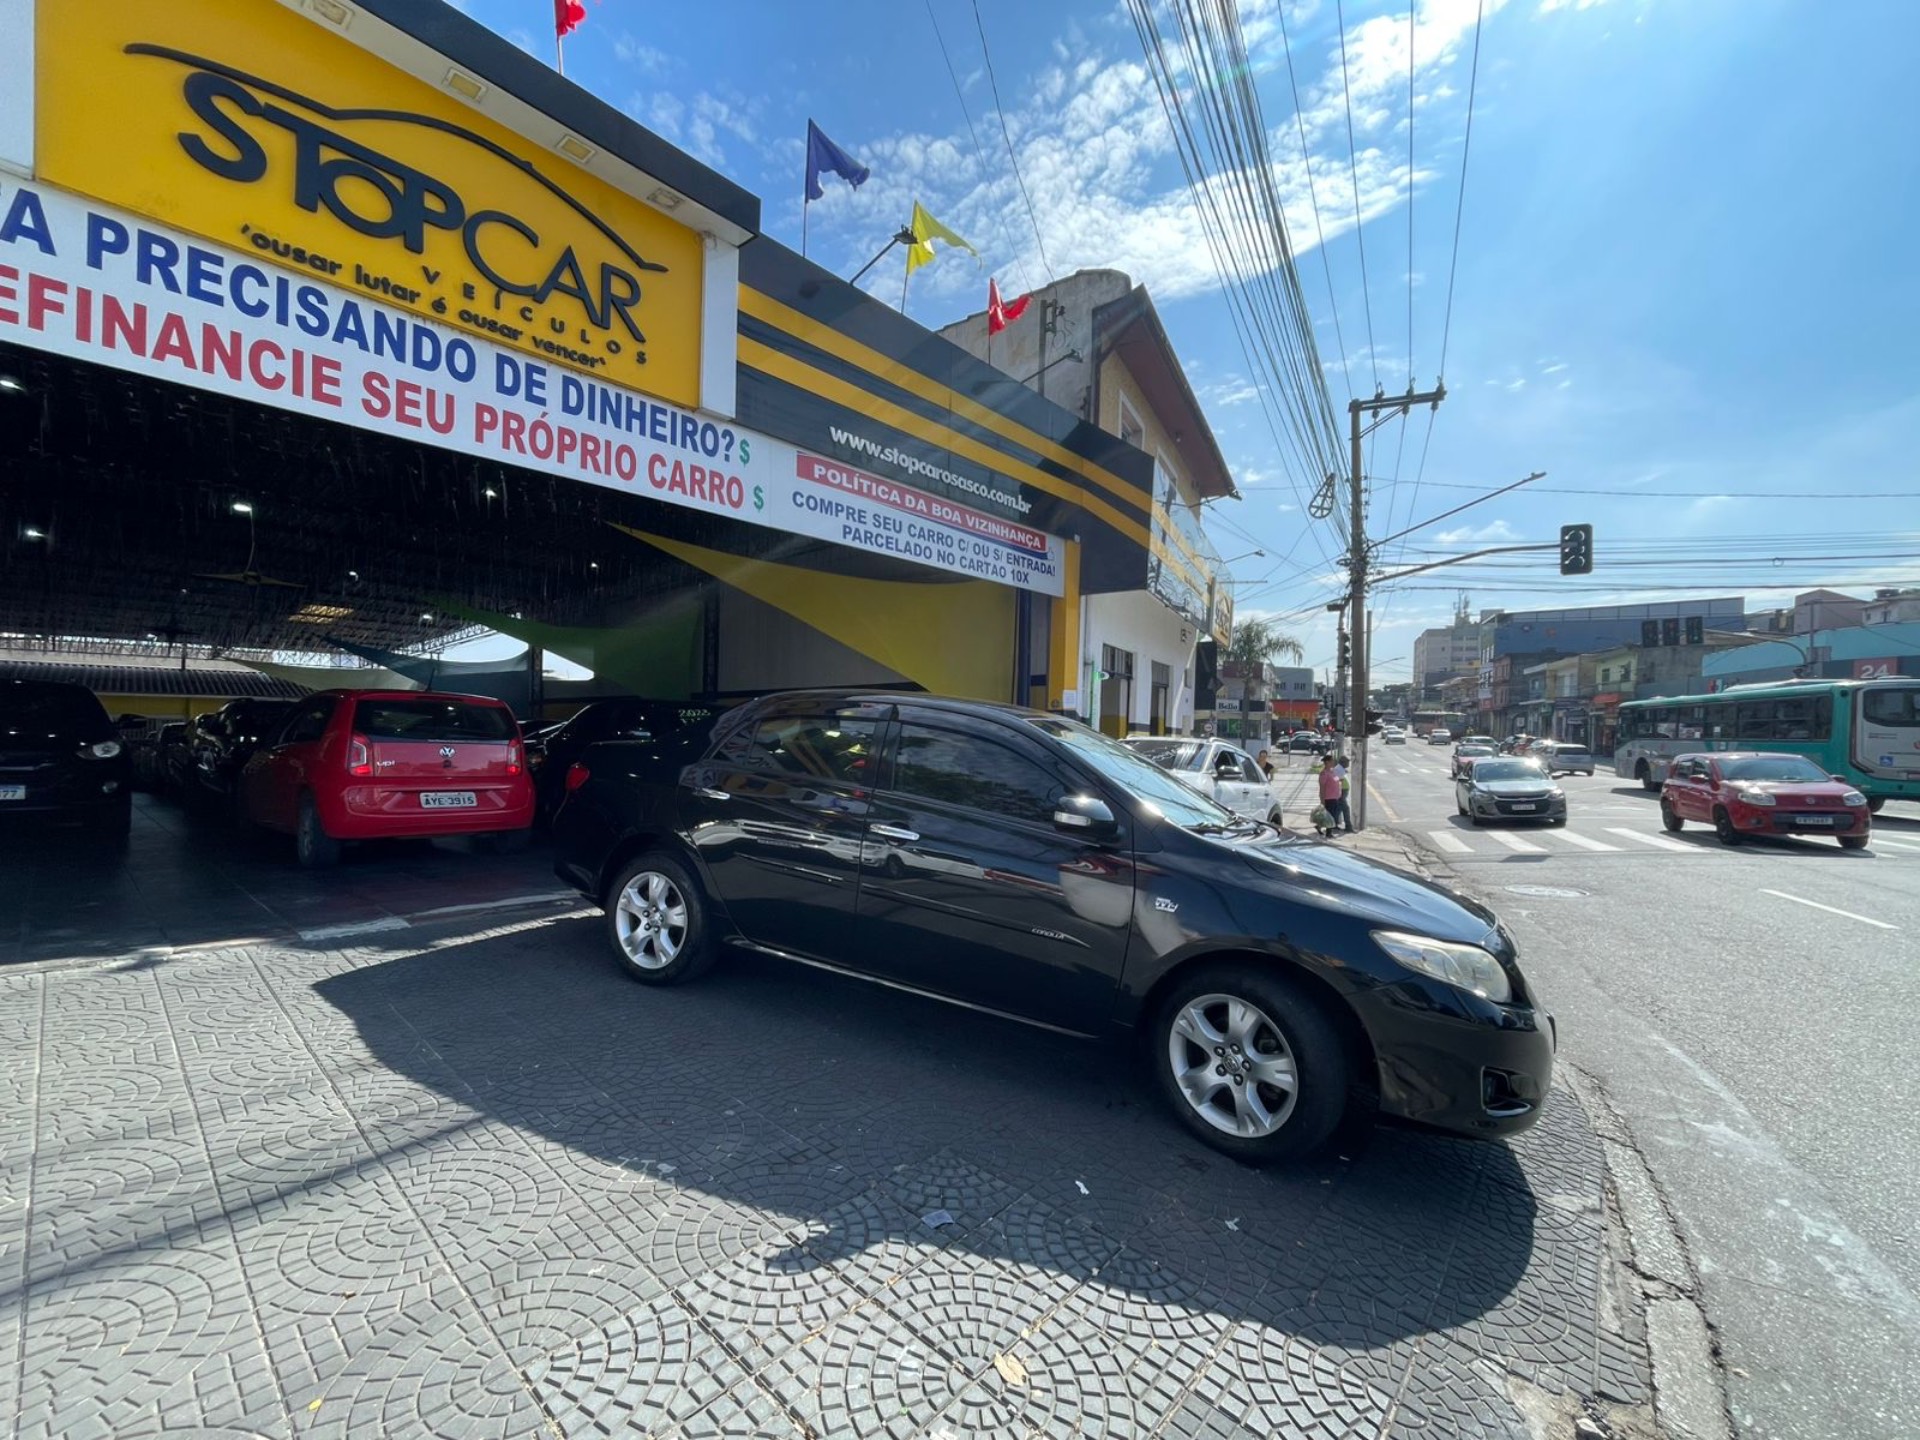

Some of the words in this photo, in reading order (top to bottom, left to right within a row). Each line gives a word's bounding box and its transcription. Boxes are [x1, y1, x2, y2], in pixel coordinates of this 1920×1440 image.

[87, 211, 476, 383] PRECISANDO
[496, 352, 547, 407] DE
[561, 374, 735, 462] DINHEIRO?
[355, 264, 421, 304] lutar
[431, 297, 447, 315] é
[459, 308, 524, 341] ousar
[361, 371, 455, 434] SEU
[475, 401, 637, 481] PRÓPRIO
[648, 453, 744, 509] CARRO
[829, 425, 1032, 514] www.stopcarosasco.com.br
[792, 490, 867, 525] COMPRE
[872, 513, 903, 534] SEU
[907, 523, 954, 548] CARRO
[957, 538, 969, 553] C/
[972, 543, 990, 560] OU
[1006, 550, 1056, 577] ENTRADA!
[813, 463, 901, 504] POLÍTICA
[904, 493, 928, 513] DA
[932, 502, 962, 523] BOA
[965, 514, 1041, 549] VIZINHANÇA
[842, 524, 933, 560] PARCELADO
[936, 549, 955, 566] NO
[1011, 568, 1030, 584] 10X
